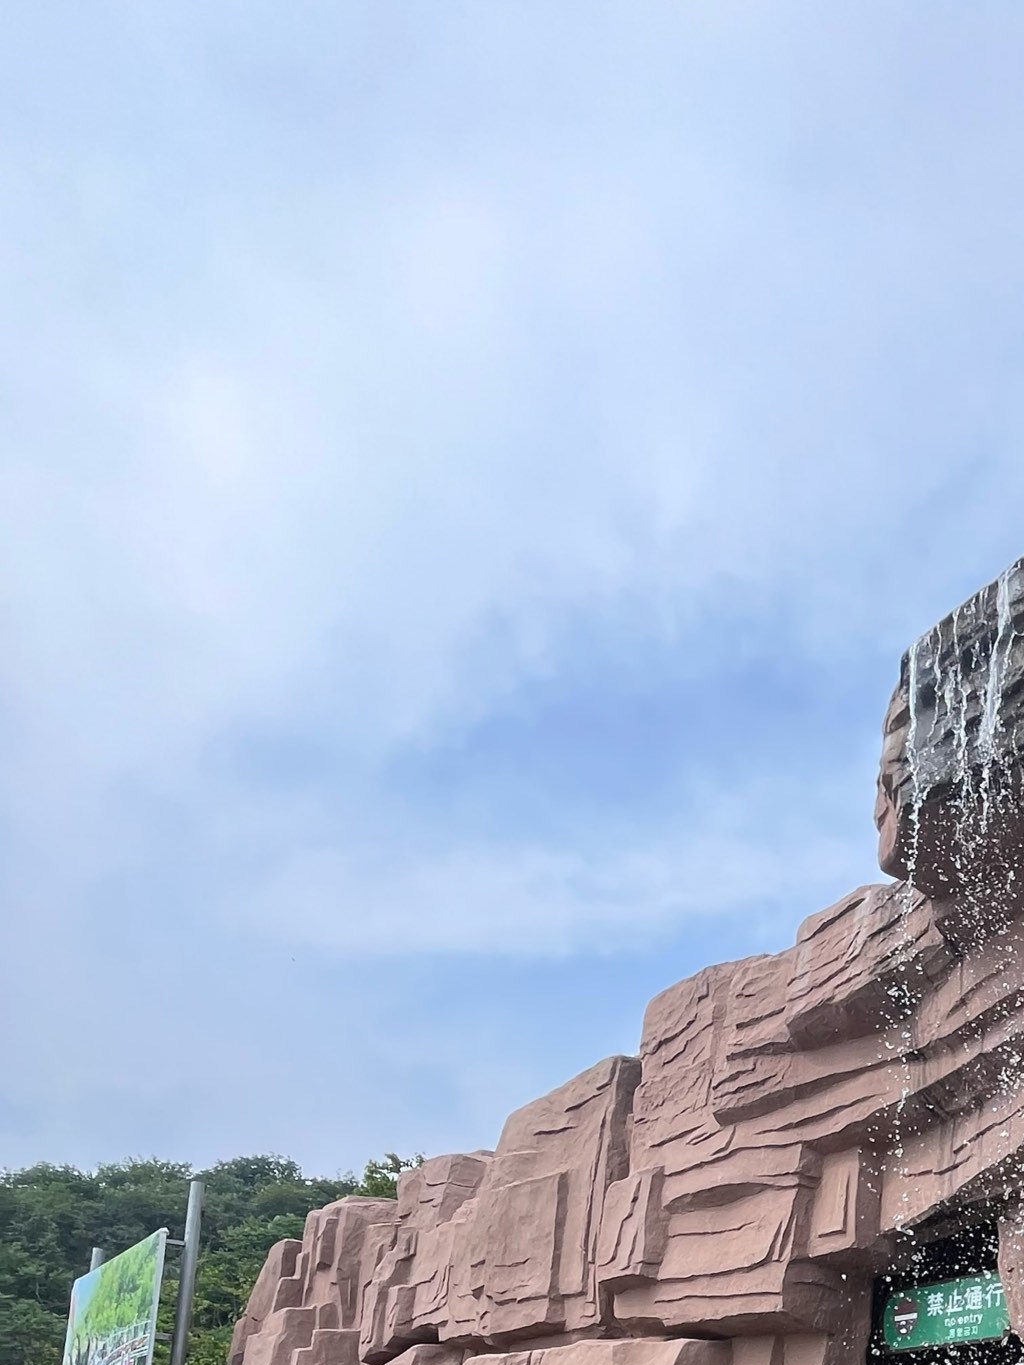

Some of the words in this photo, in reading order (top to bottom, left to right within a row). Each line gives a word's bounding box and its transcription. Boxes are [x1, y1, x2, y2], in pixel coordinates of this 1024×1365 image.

[927, 1283, 1004, 1316] 禁止通行
[957, 1313, 983, 1325] entry
